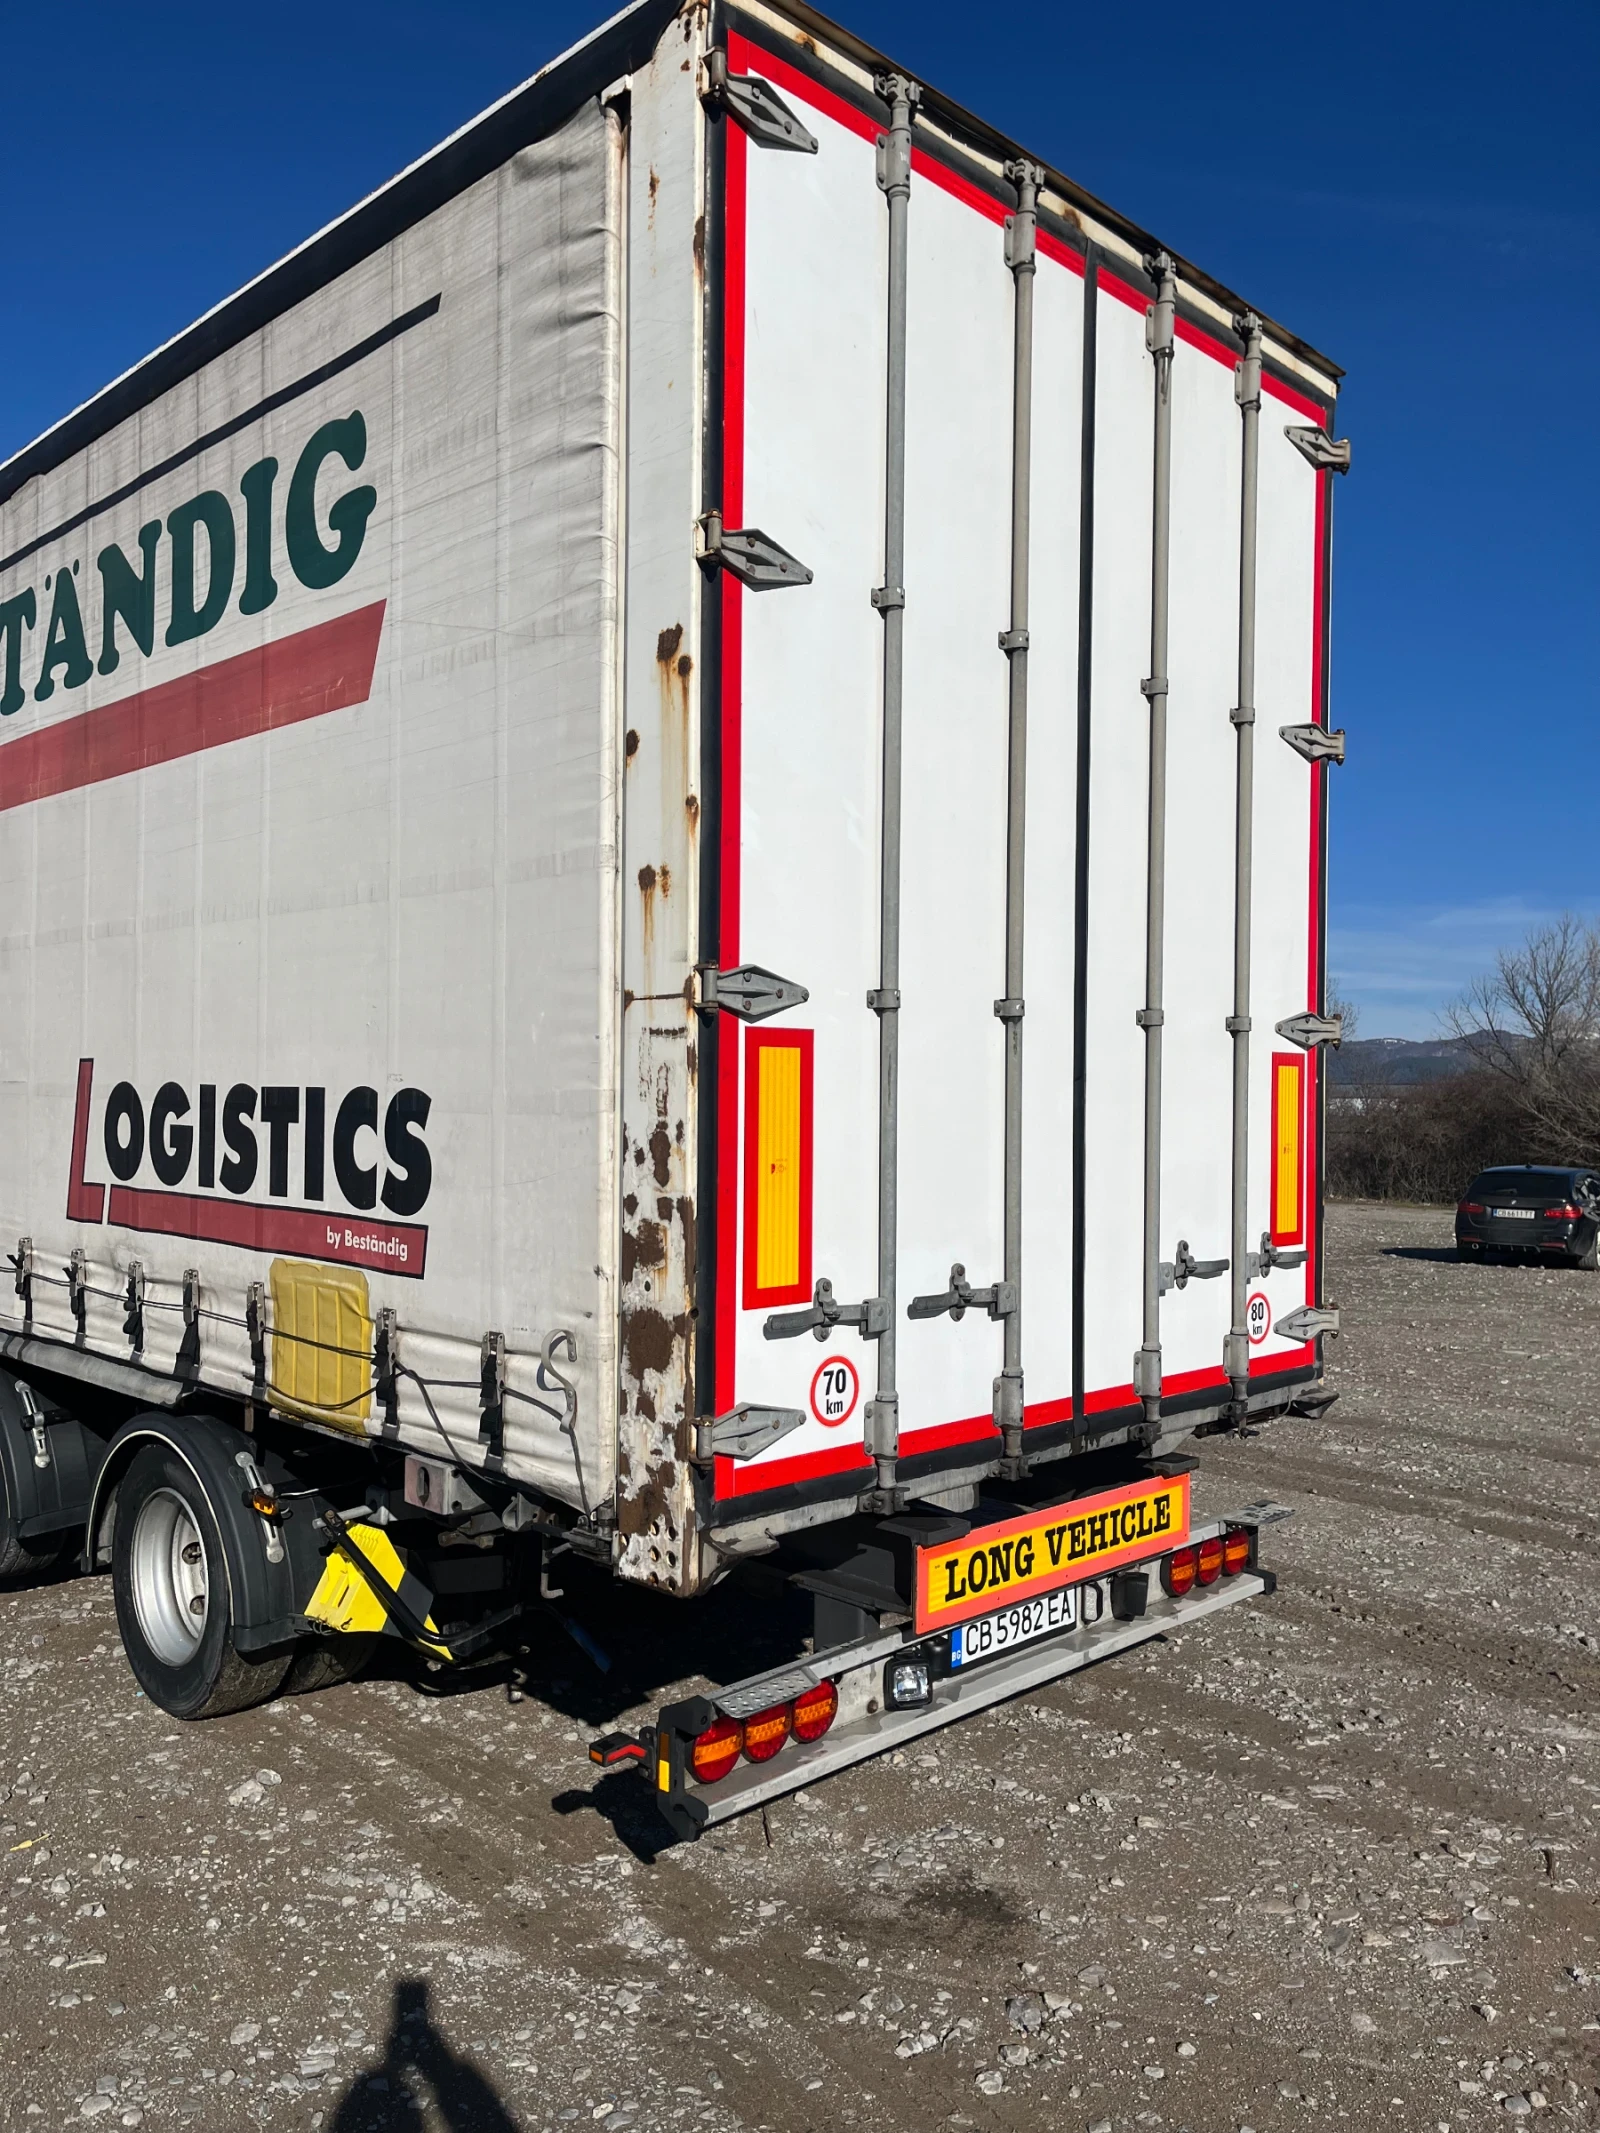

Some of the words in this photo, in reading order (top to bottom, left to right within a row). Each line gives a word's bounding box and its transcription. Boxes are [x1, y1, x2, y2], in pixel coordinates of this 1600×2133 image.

[66, 1057, 432, 1225] LOGISTICS
[326, 1225, 341, 1249] by
[344, 1229, 408, 1262] Beständig
[1251, 1302, 1264, 1322] 80
[1252, 1324, 1263, 1335] km
[823, 1368, 846, 1396] 70
[826, 1399, 843, 1415] km
[945, 1535, 1035, 1602] LONG
[1045, 1494, 1170, 1566] VEHICLE
[966, 1620, 992, 1656] CB
[996, 1600, 1044, 1644] 5982
[1048, 1590, 1072, 1626] EA
[951, 1650, 961, 1662] BG
